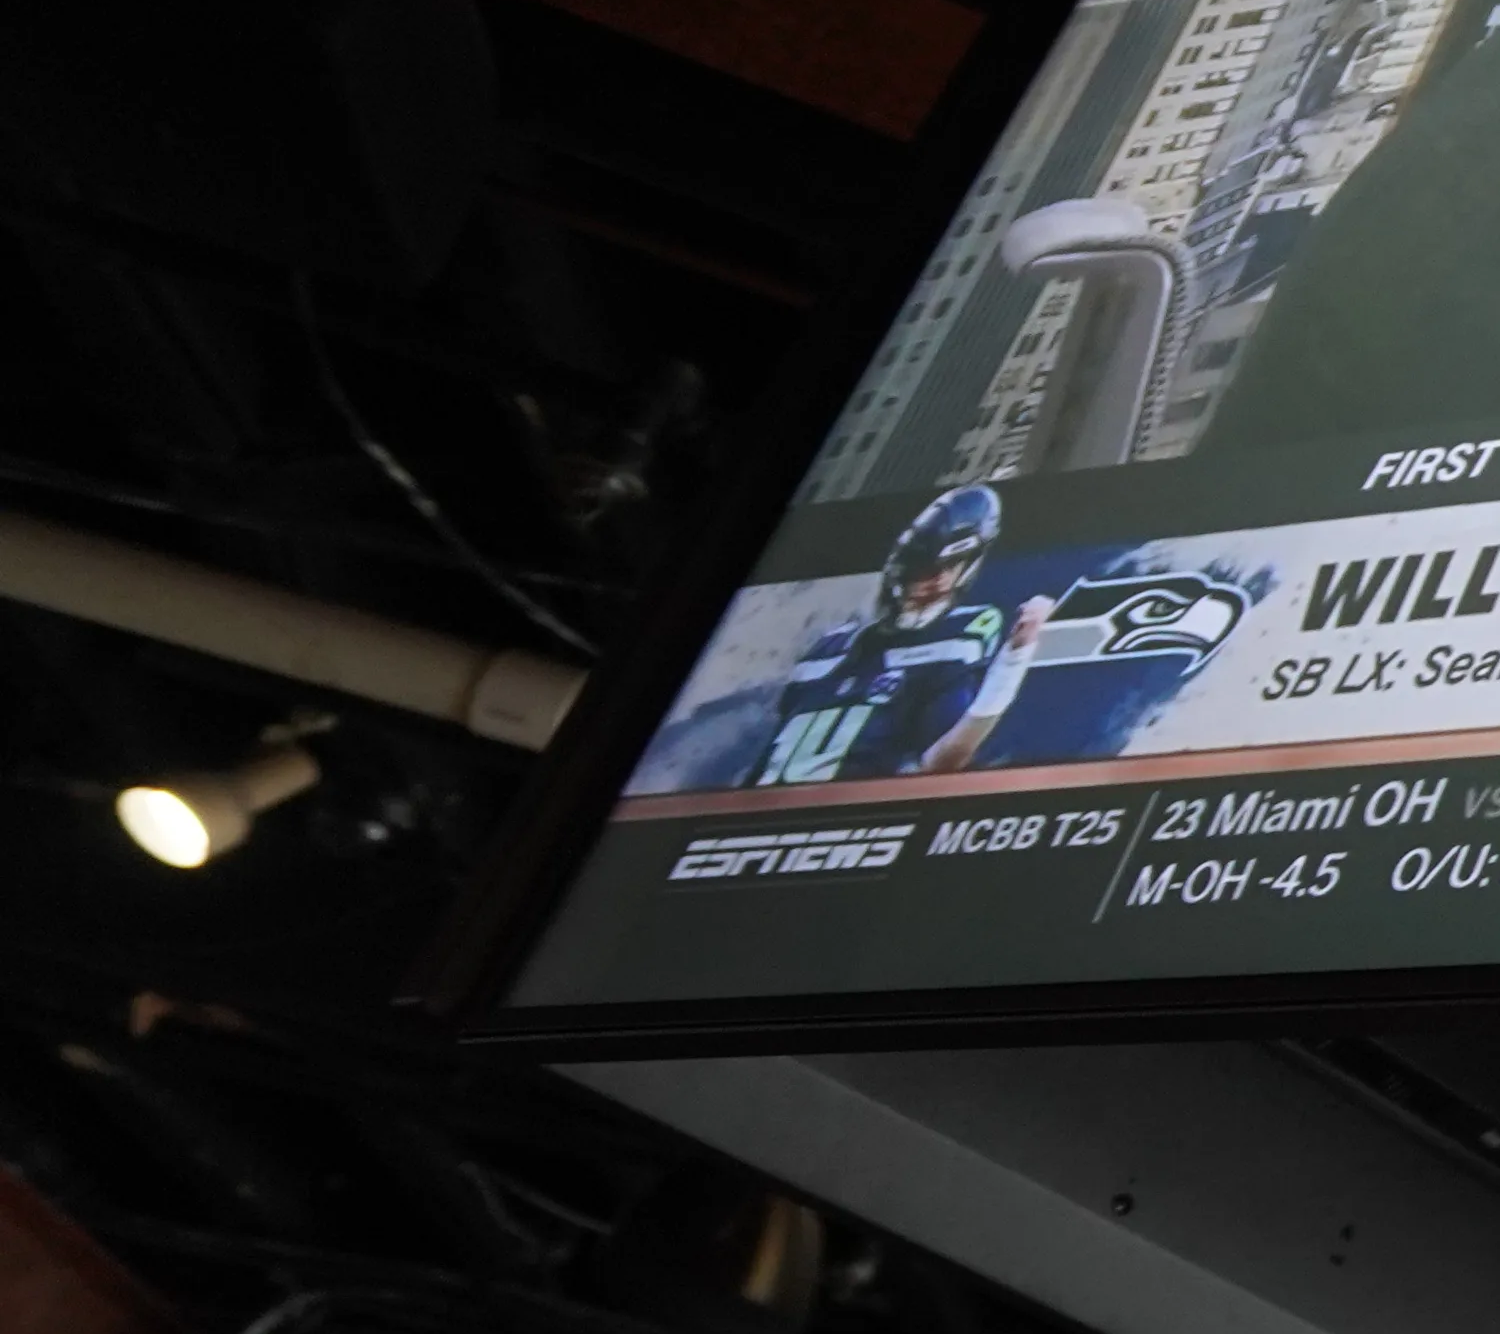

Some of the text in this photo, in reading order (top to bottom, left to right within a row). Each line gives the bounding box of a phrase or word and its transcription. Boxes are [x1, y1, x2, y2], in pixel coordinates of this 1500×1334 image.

[1301, 545, 1500, 632] WILL
[1262, 658, 1331, 700] SB
[1333, 650, 1405, 694] LX:
[927, 809, 1125, 855] MCBB T25
[1152, 799, 1206, 840] 23
[1207, 784, 1360, 836] Miami
[1365, 778, 1447, 826] OH
[667, 823, 916, 881] ESPNEWS
[1127, 852, 1347, 905] M-OH -4.5
[1392, 844, 1498, 891] O/U:
